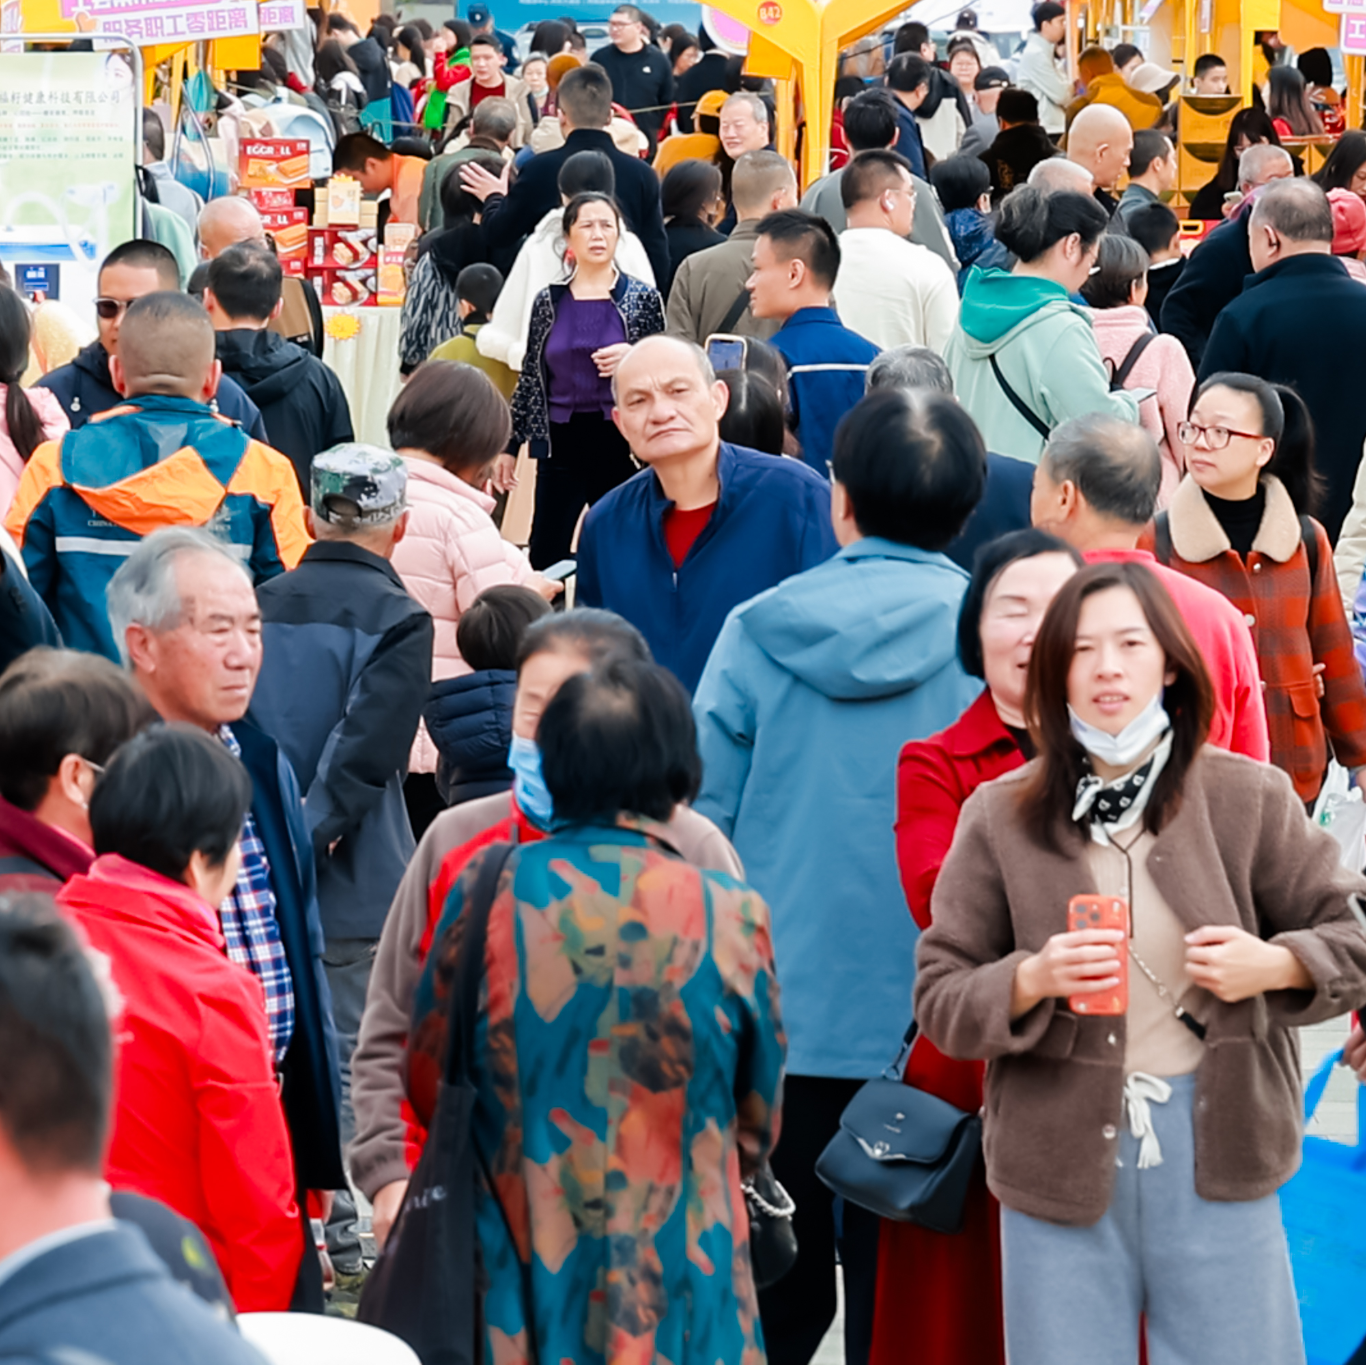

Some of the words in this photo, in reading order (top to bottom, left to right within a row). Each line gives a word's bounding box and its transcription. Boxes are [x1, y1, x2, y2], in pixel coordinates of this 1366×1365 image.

[101, 6, 249, 44] 服务职工零距离
